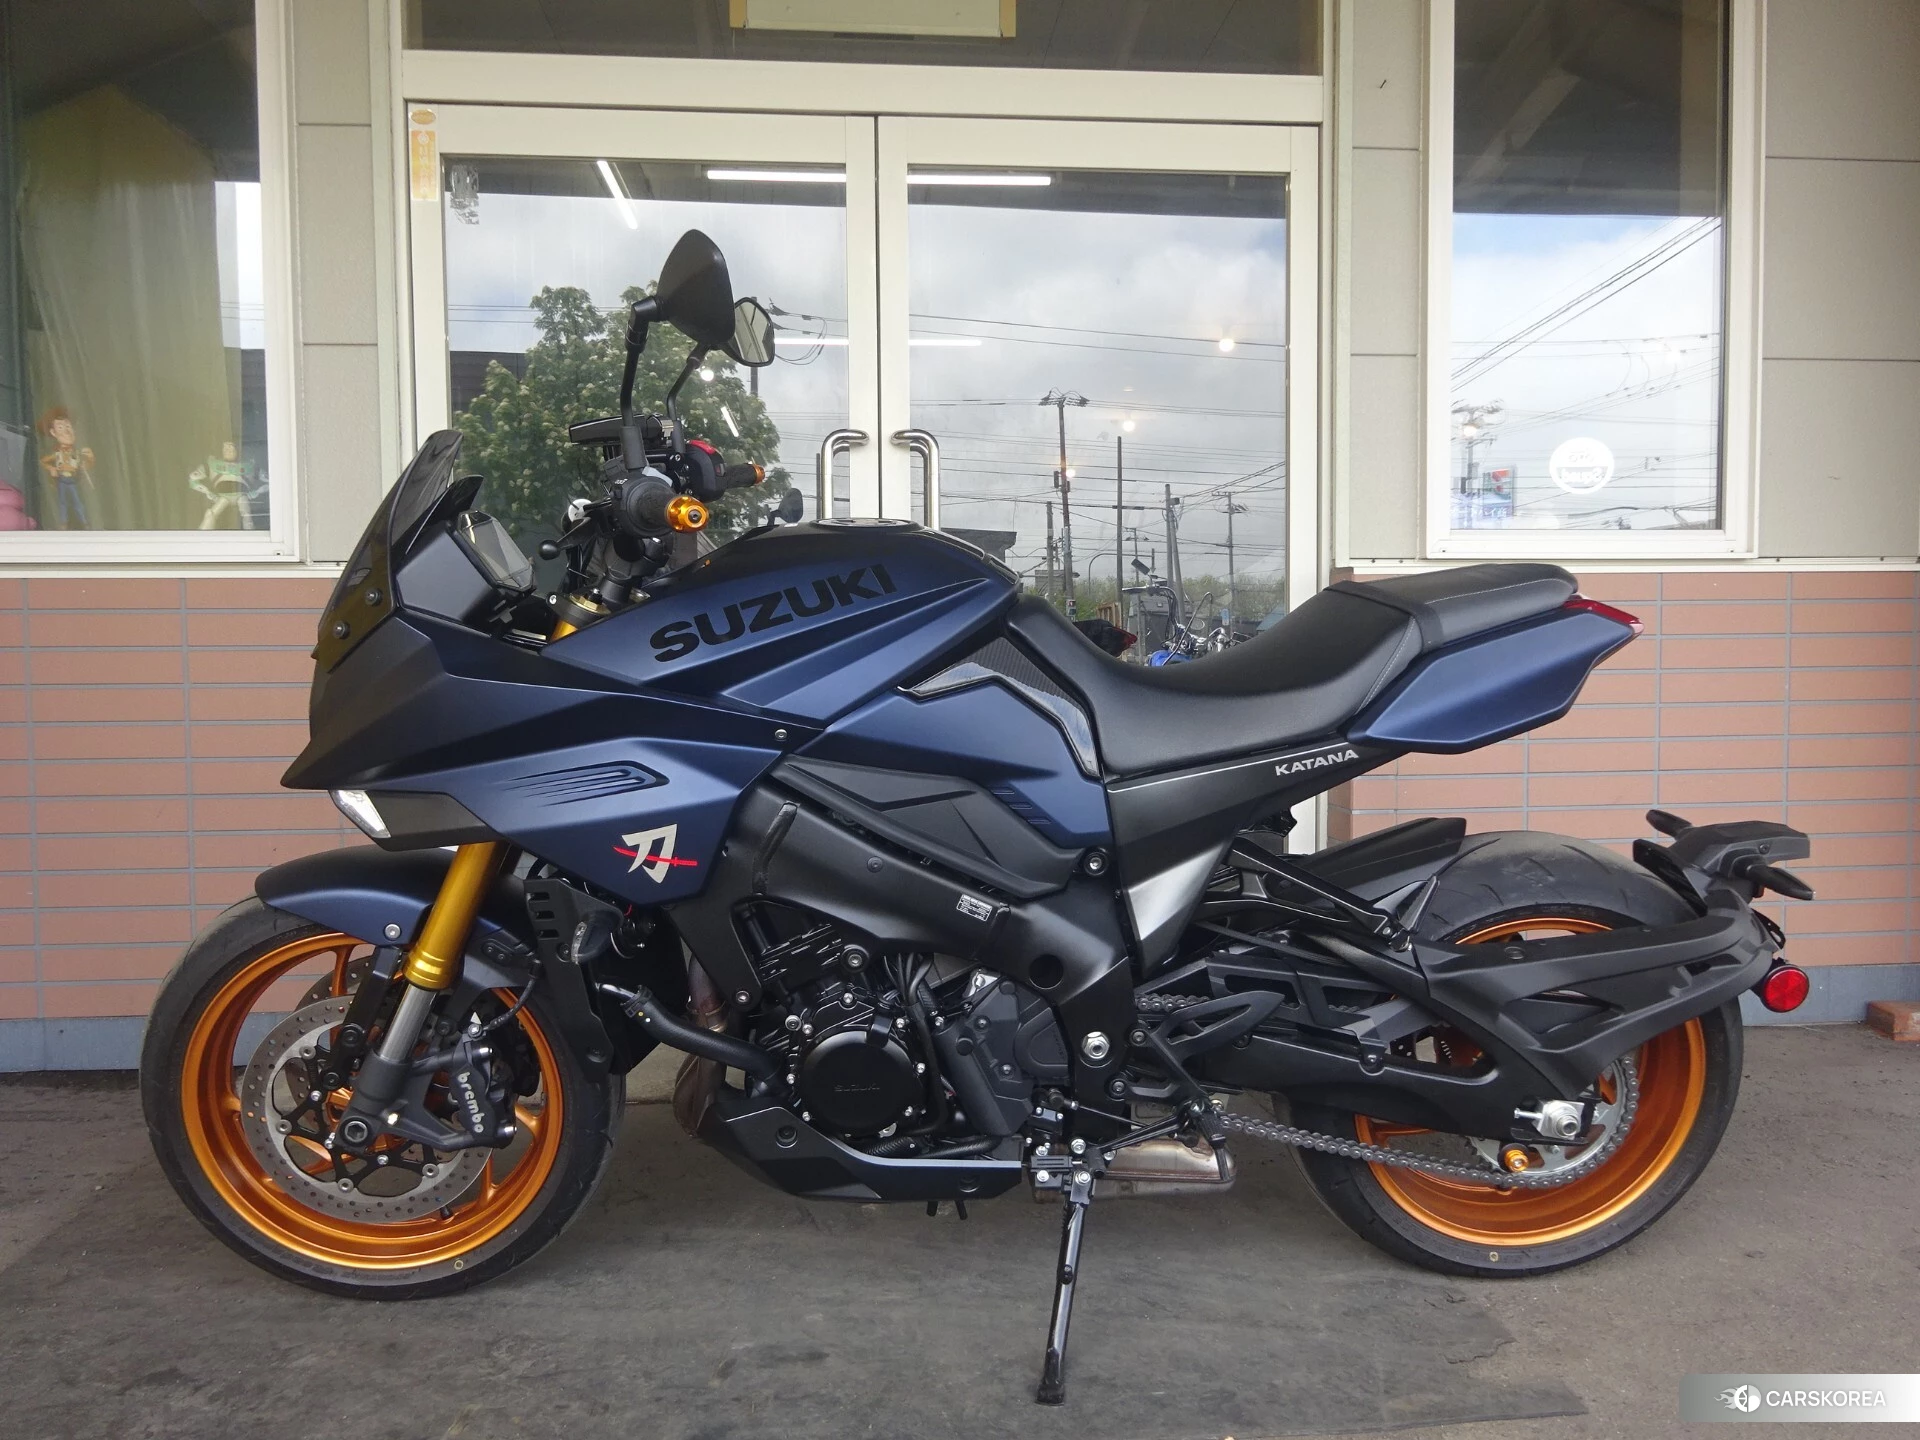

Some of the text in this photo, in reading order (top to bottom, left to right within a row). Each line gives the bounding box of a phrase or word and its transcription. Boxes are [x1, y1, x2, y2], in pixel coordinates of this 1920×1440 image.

[650, 563, 897, 662] SUZUKI
[1275, 749, 1359, 776] KATANA
[621, 823, 678, 884] 刀
[457, 1071, 485, 1133] brembo
